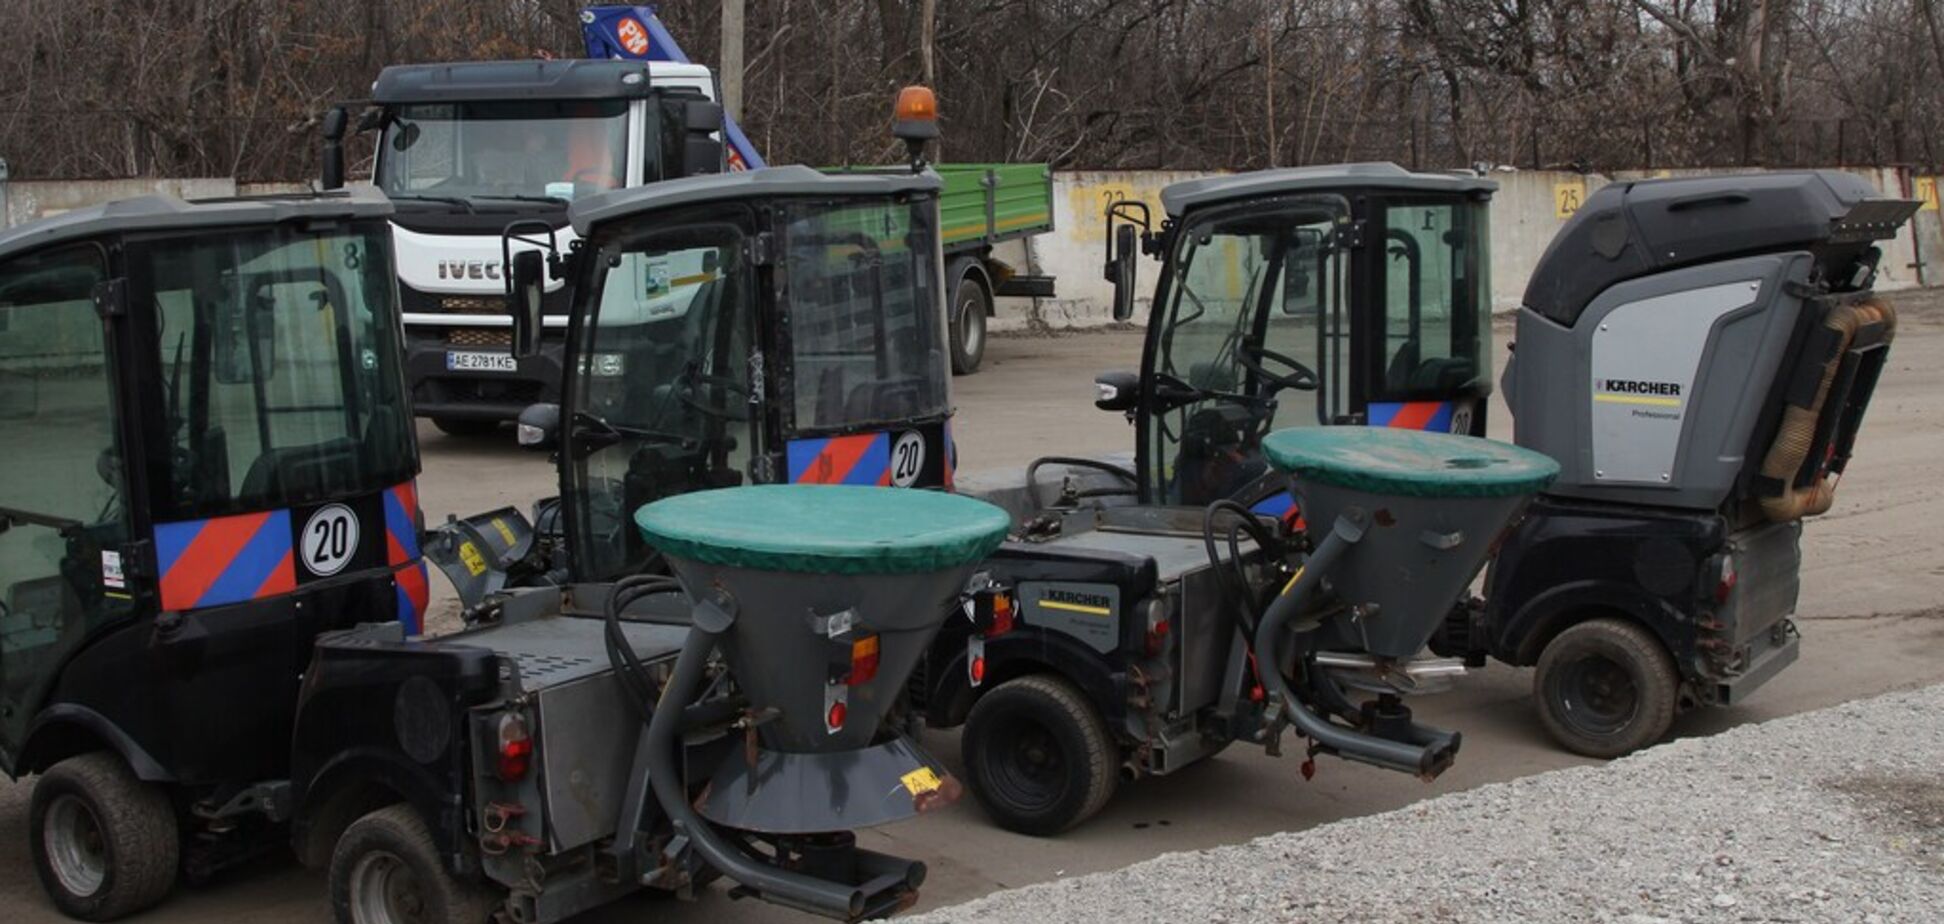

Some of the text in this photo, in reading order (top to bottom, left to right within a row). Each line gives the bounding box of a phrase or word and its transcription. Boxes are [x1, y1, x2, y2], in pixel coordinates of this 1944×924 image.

[618, 19, 649, 54] PM
[1561, 189, 1579, 214] 25
[343, 242, 360, 270] 8
[455, 354, 470, 368] AE
[471, 355, 496, 369] 2781
[498, 356, 514, 370] KE
[896, 440, 919, 480] 20
[313, 515, 348, 564] 20
